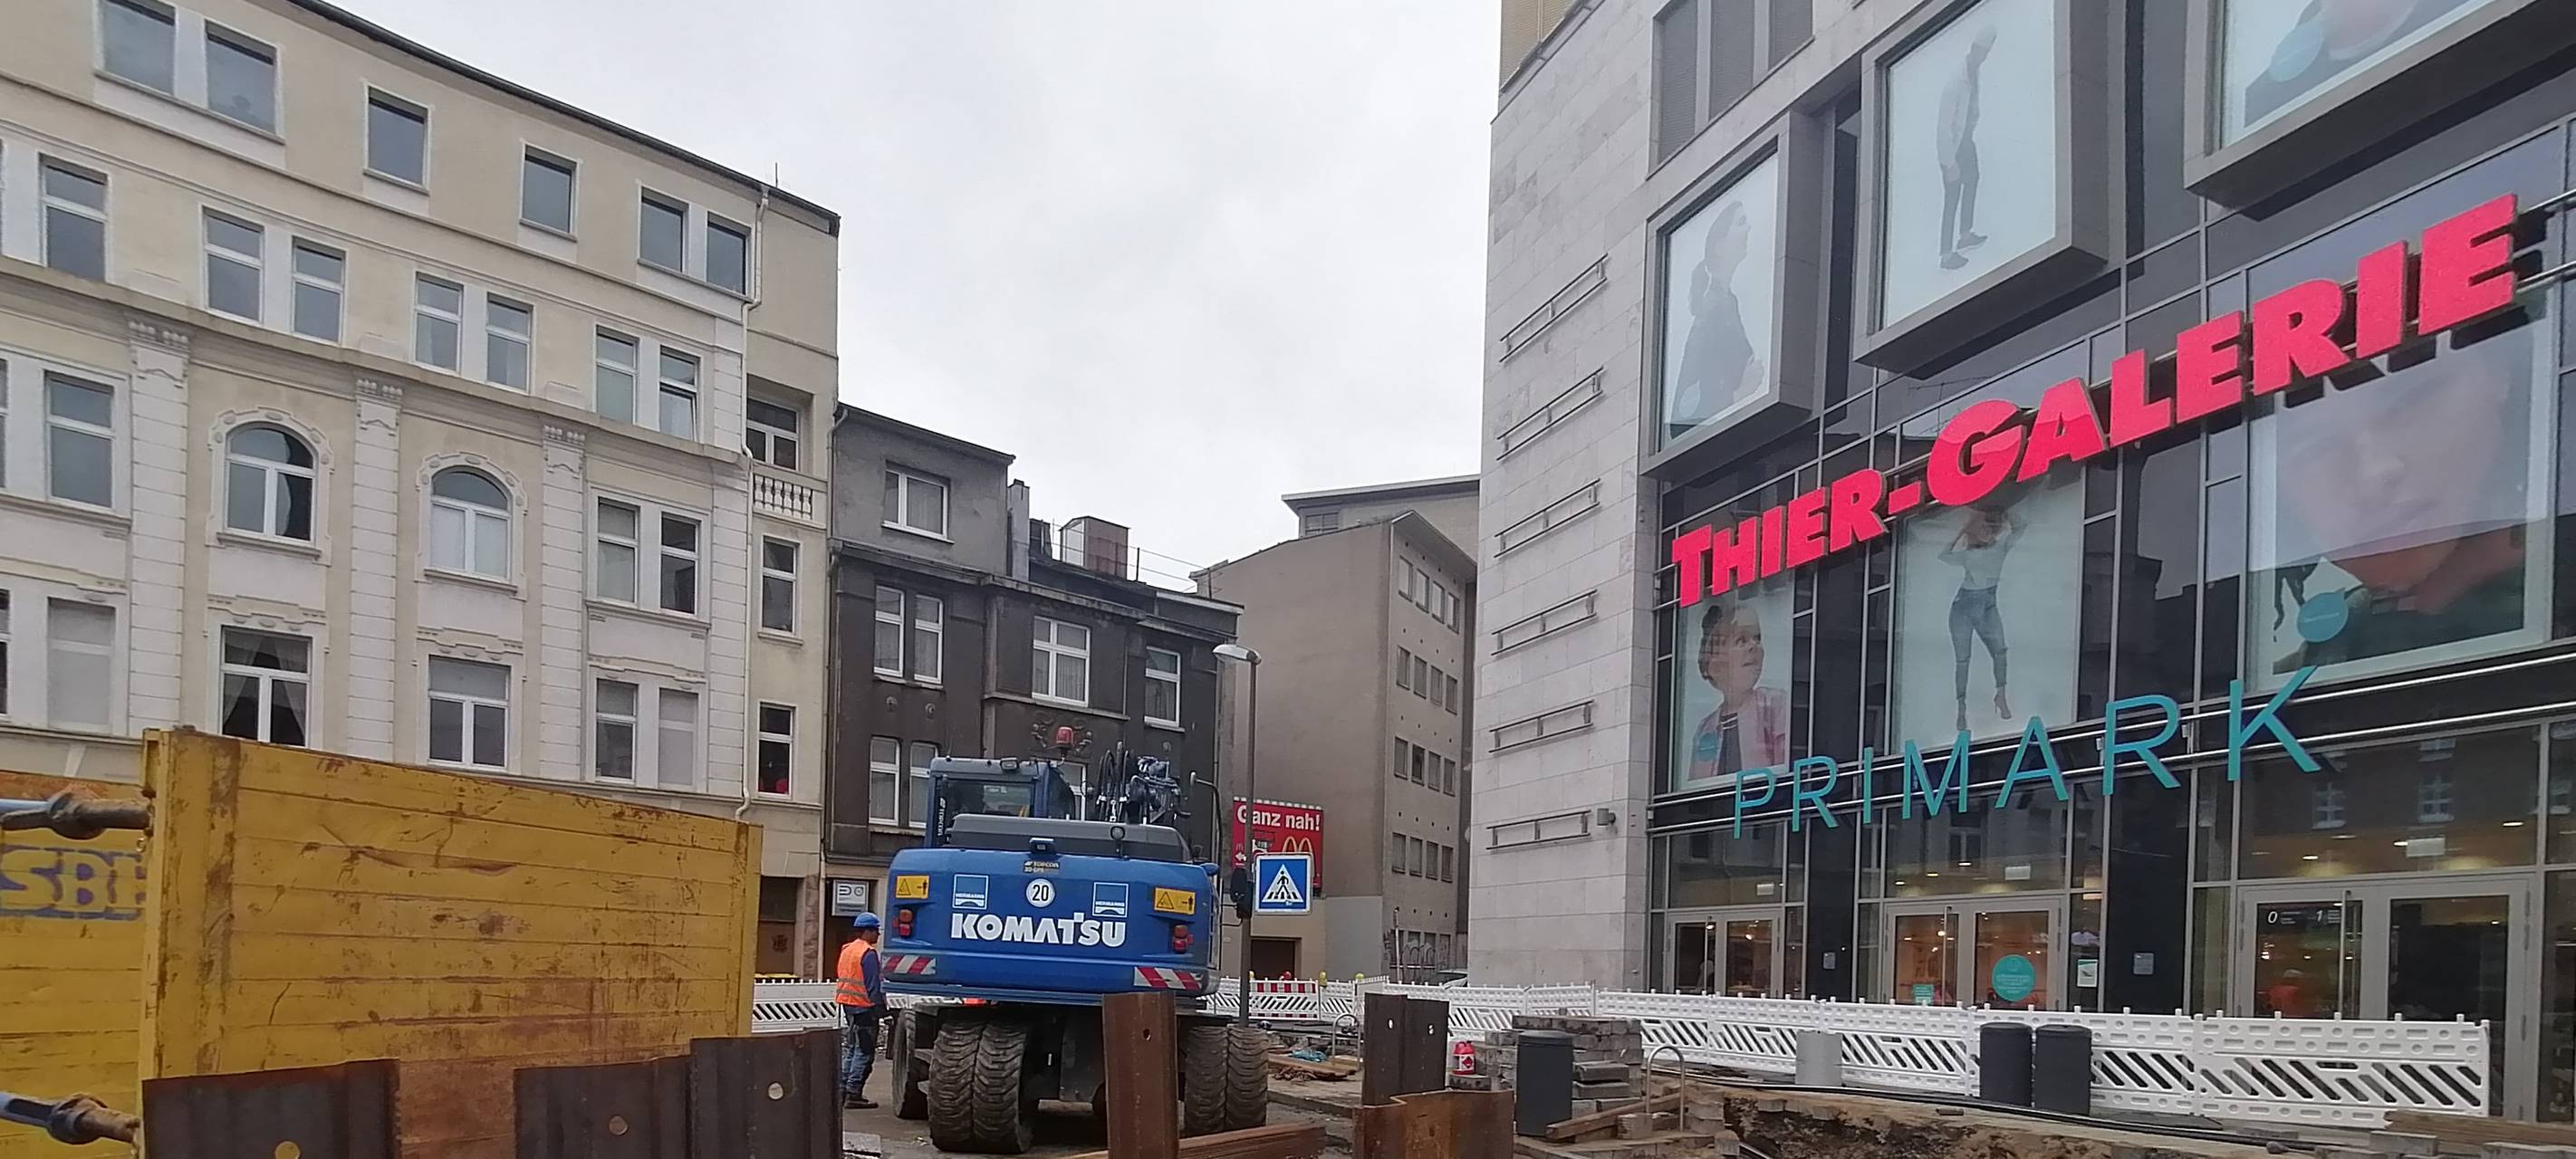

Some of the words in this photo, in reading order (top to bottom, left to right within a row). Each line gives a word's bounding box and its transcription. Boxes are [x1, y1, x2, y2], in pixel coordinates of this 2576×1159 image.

[1734, 666, 2321, 839] PRIMARK
[1237, 805, 1281, 827] Ganz
[1286, 812, 1320, 831] nah!
[1033, 885, 1049, 901] 20
[951, 912, 1126, 947] KOMATSU
